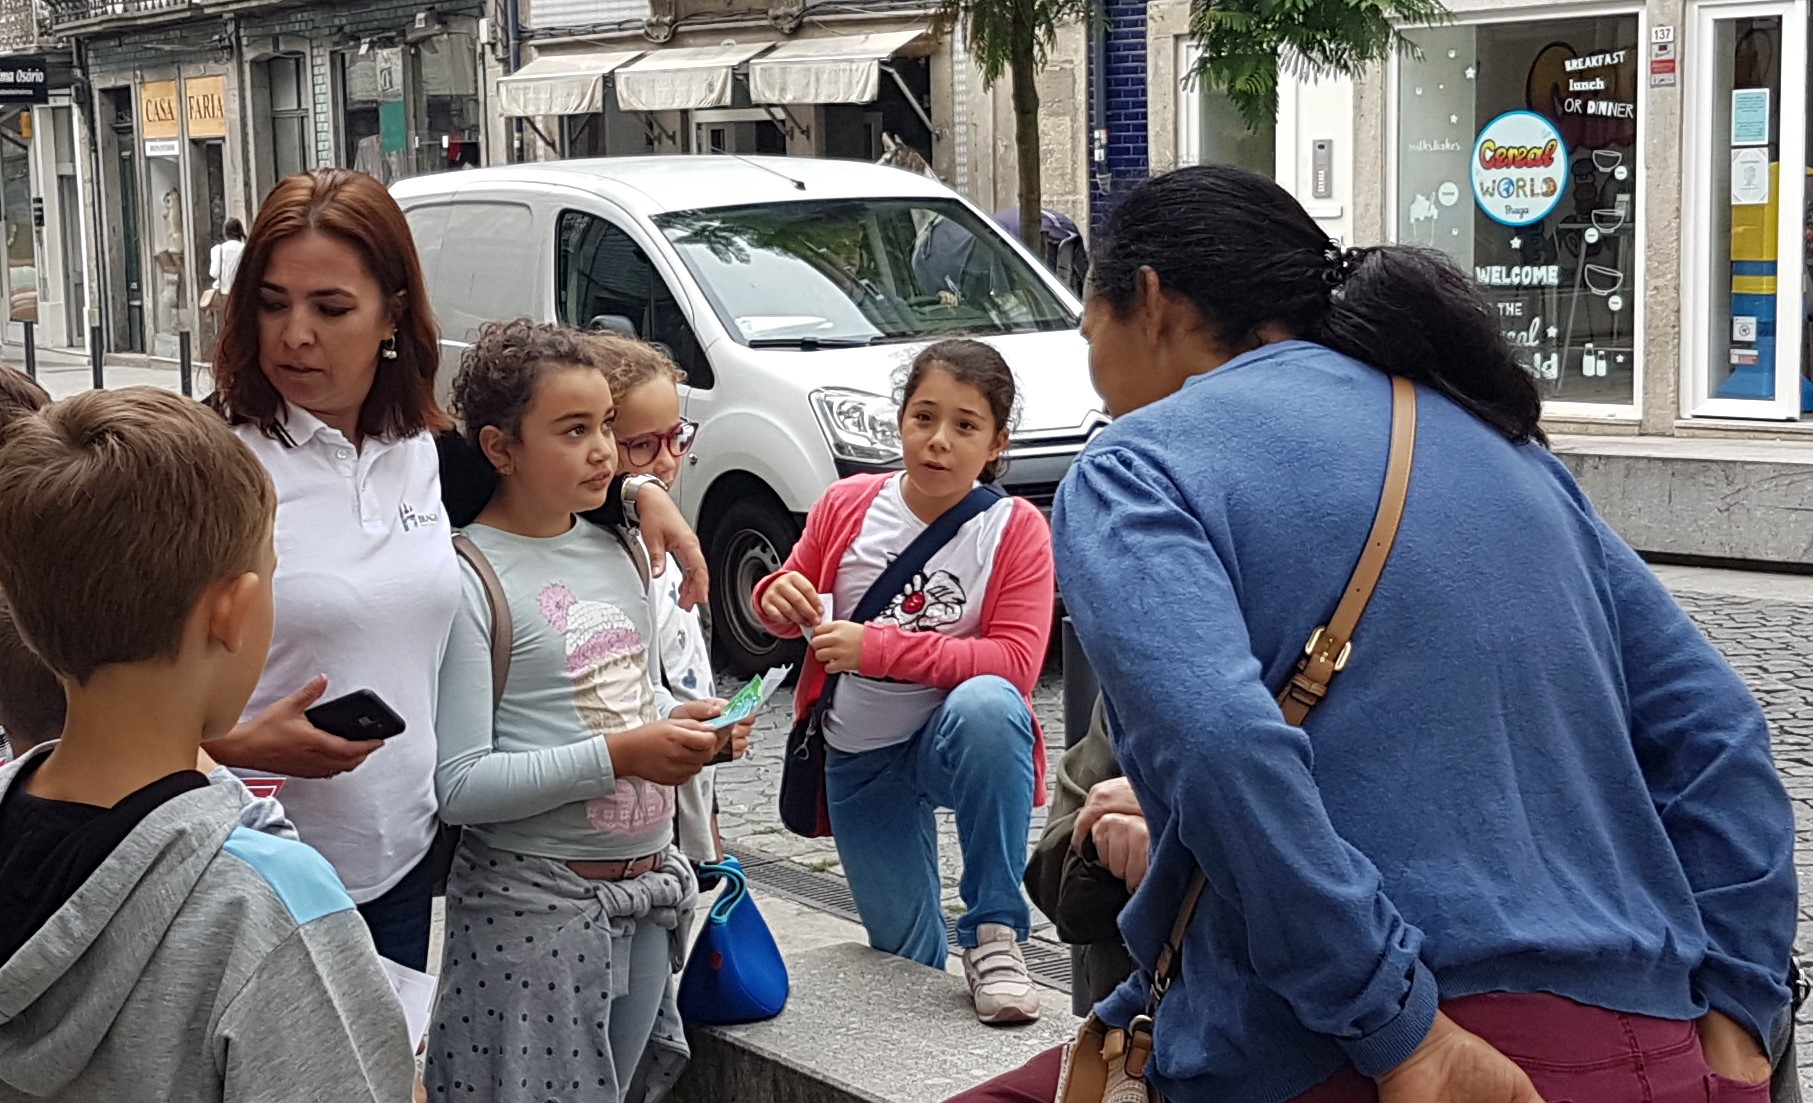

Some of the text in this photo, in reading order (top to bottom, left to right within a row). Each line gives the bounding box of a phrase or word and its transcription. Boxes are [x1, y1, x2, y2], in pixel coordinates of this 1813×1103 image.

[1654, 28, 1671, 41] 137
[1564, 50, 1626, 72] BREAKFAST
[16, 68, 44, 83] Osório
[1568, 77, 1605, 92] lunch
[145, 93, 224, 123] CASA FARIA
[1564, 98, 1634, 119] OR DINNER
[1479, 138, 1558, 170] Cereal
[1480, 176, 1557, 198] WORLD
[1504, 204, 1529, 219] Braga
[1475, 265, 1559, 286] WELCOME
[1496, 302, 1523, 316] THE
